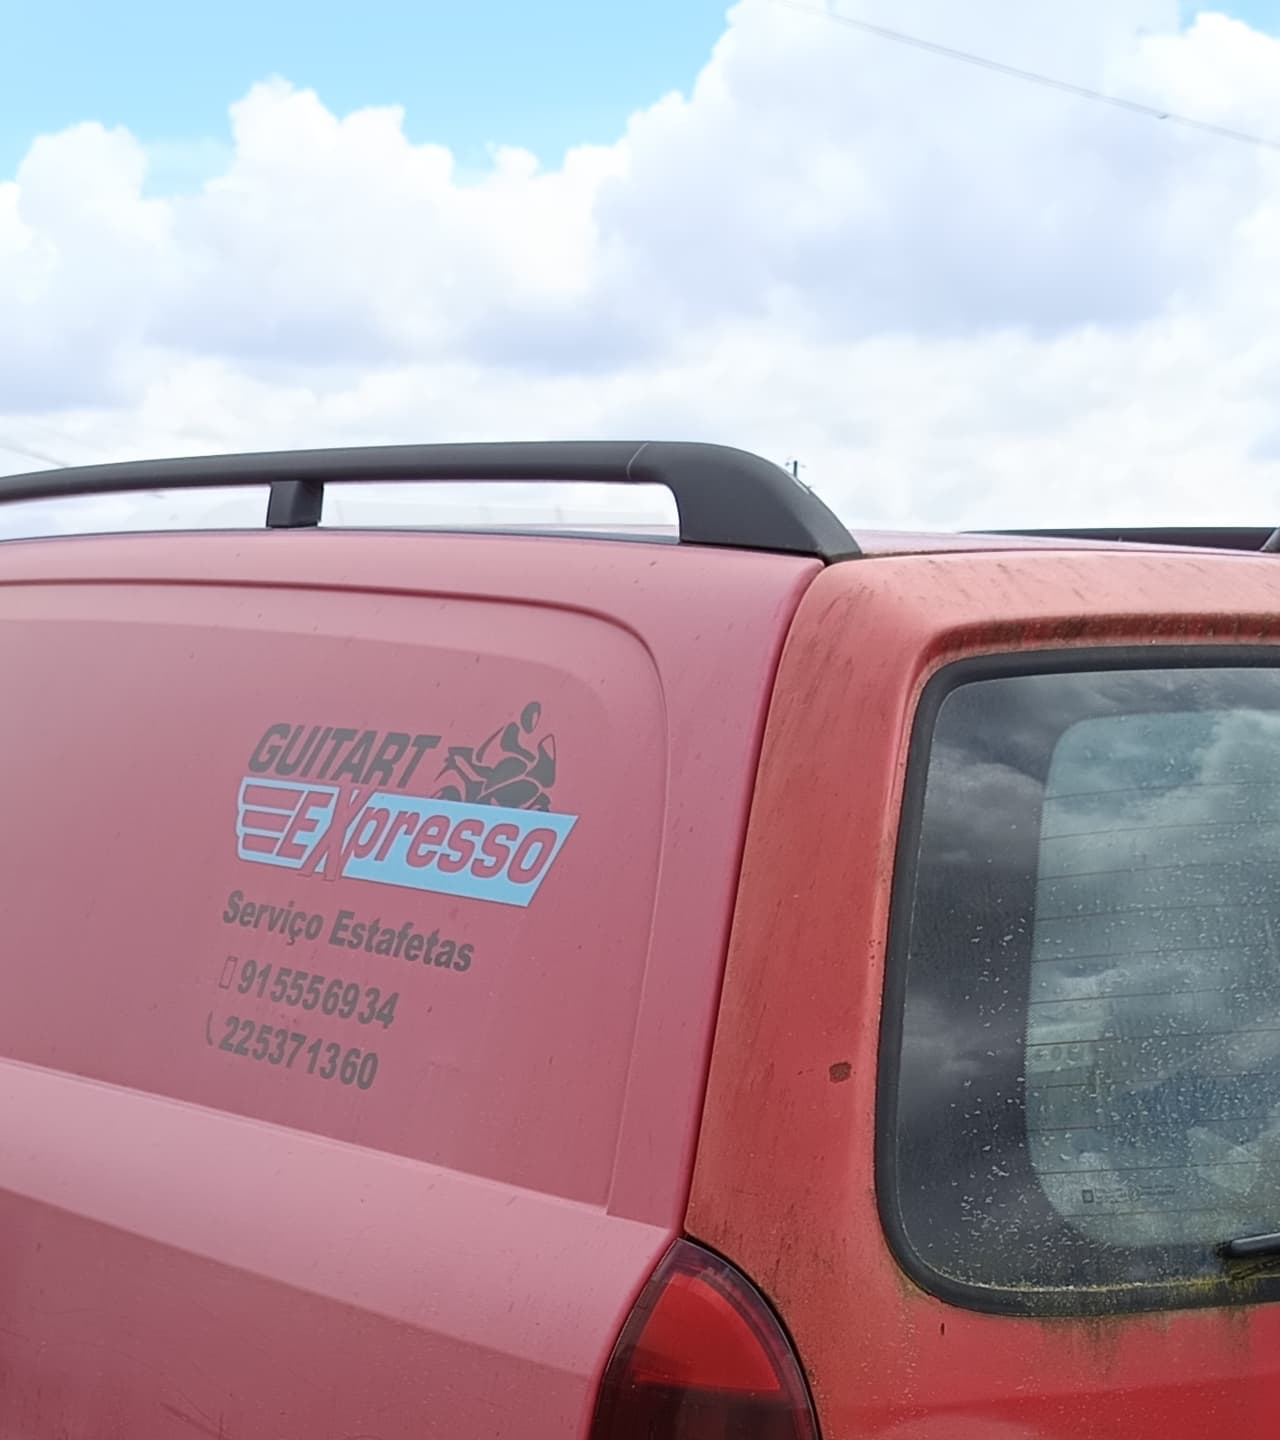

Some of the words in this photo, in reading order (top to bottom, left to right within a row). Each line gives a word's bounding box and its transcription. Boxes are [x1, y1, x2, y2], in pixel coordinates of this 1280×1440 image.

[248, 723, 442, 788] GUITART
[223, 889, 324, 946] Serviço
[328, 909, 475, 973] Estafetas
